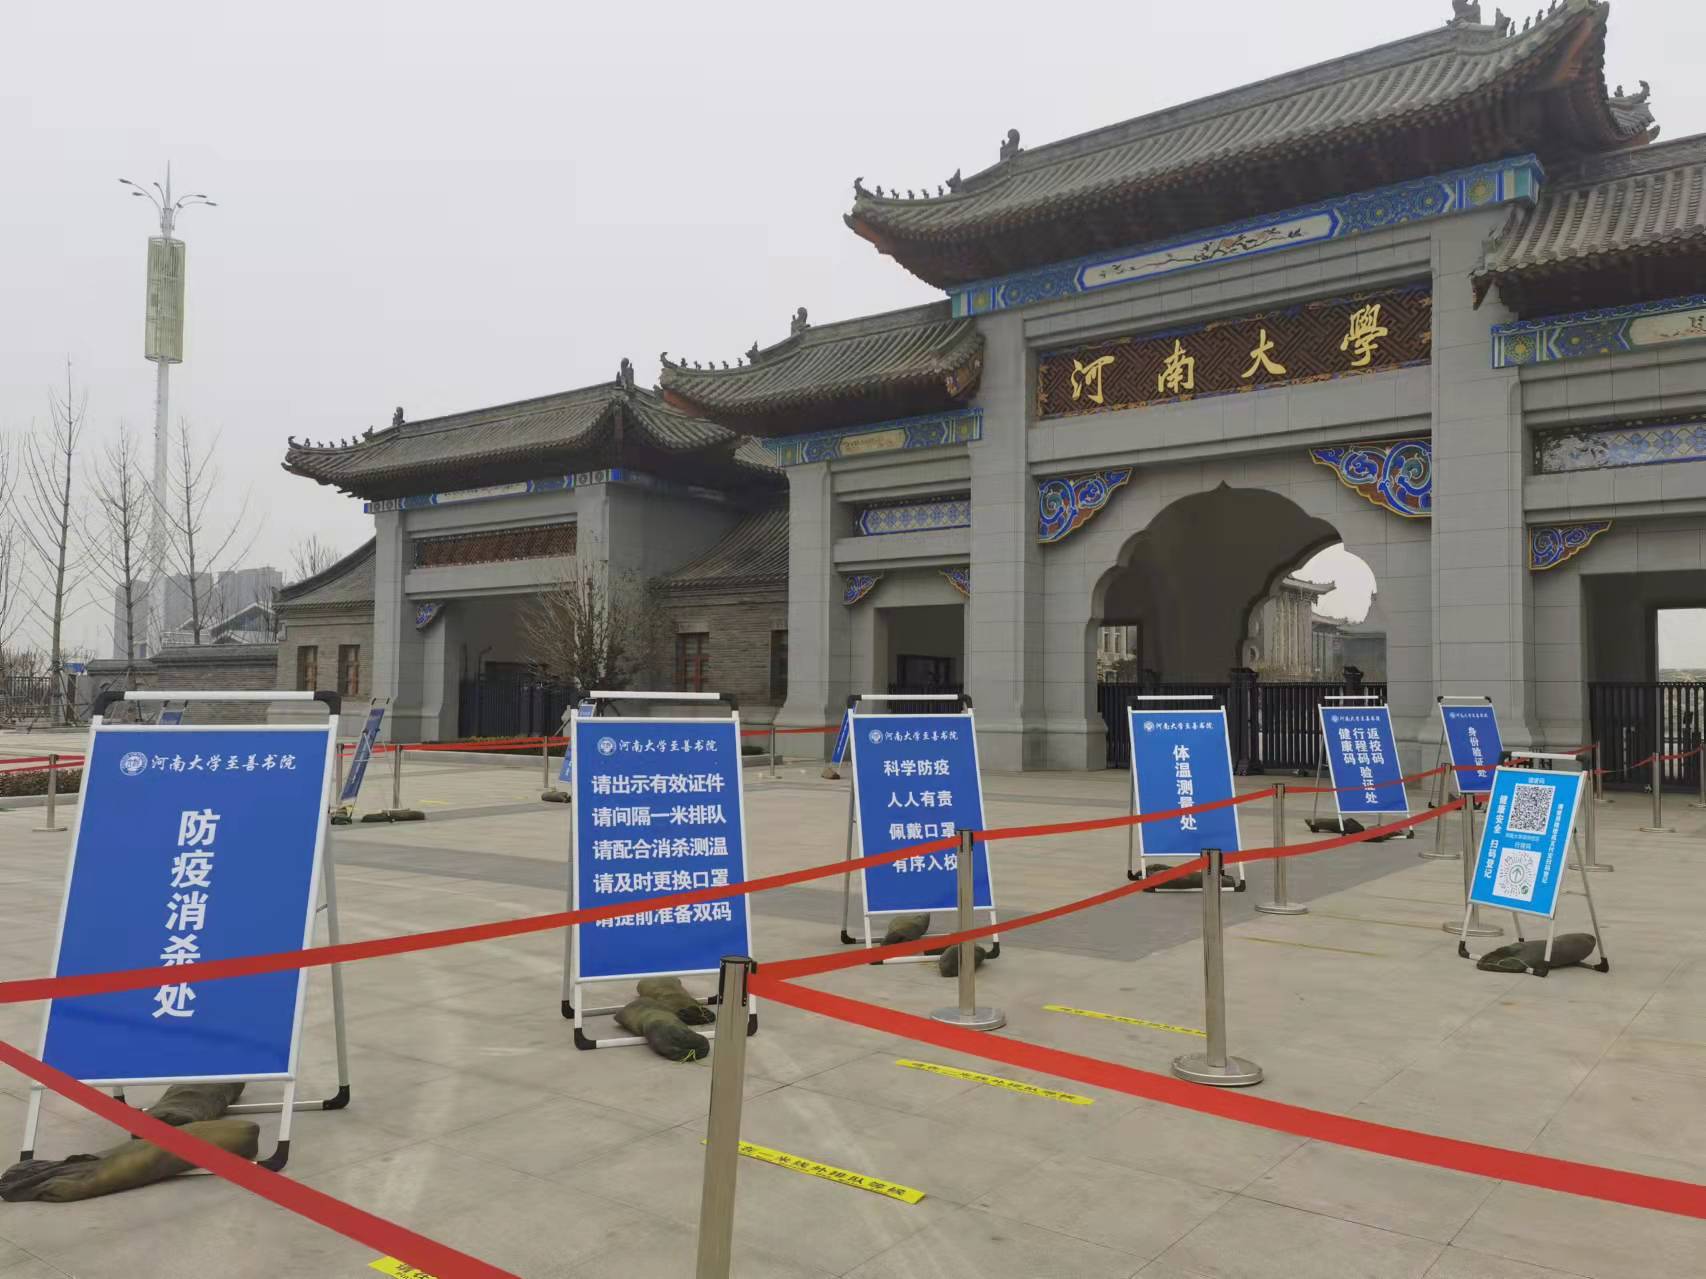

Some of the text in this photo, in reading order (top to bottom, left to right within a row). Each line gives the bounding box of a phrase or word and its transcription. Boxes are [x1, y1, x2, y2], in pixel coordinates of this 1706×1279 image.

[1071, 304, 1388, 404] 河南大學
[618, 738, 718, 753] 河南大学至善书院
[884, 730, 959, 742] 河南大学至善书院
[151, 753, 297, 773] 河南大学至善书院
[884, 759, 950, 776] 科学防疫
[592, 773, 725, 794] 请出示有效证件
[1173, 745, 1197, 830] 体温测量处
[887, 790, 953, 808] 人人有责
[592, 804, 727, 828] 请间隔一米排队
[889, 822, 956, 840] 佩戴口罩
[592, 836, 729, 861] 请配合消杀测温
[593, 869, 730, 894] 请及时更换口罩
[152, 809, 220, 1018] 防疫消杀处
